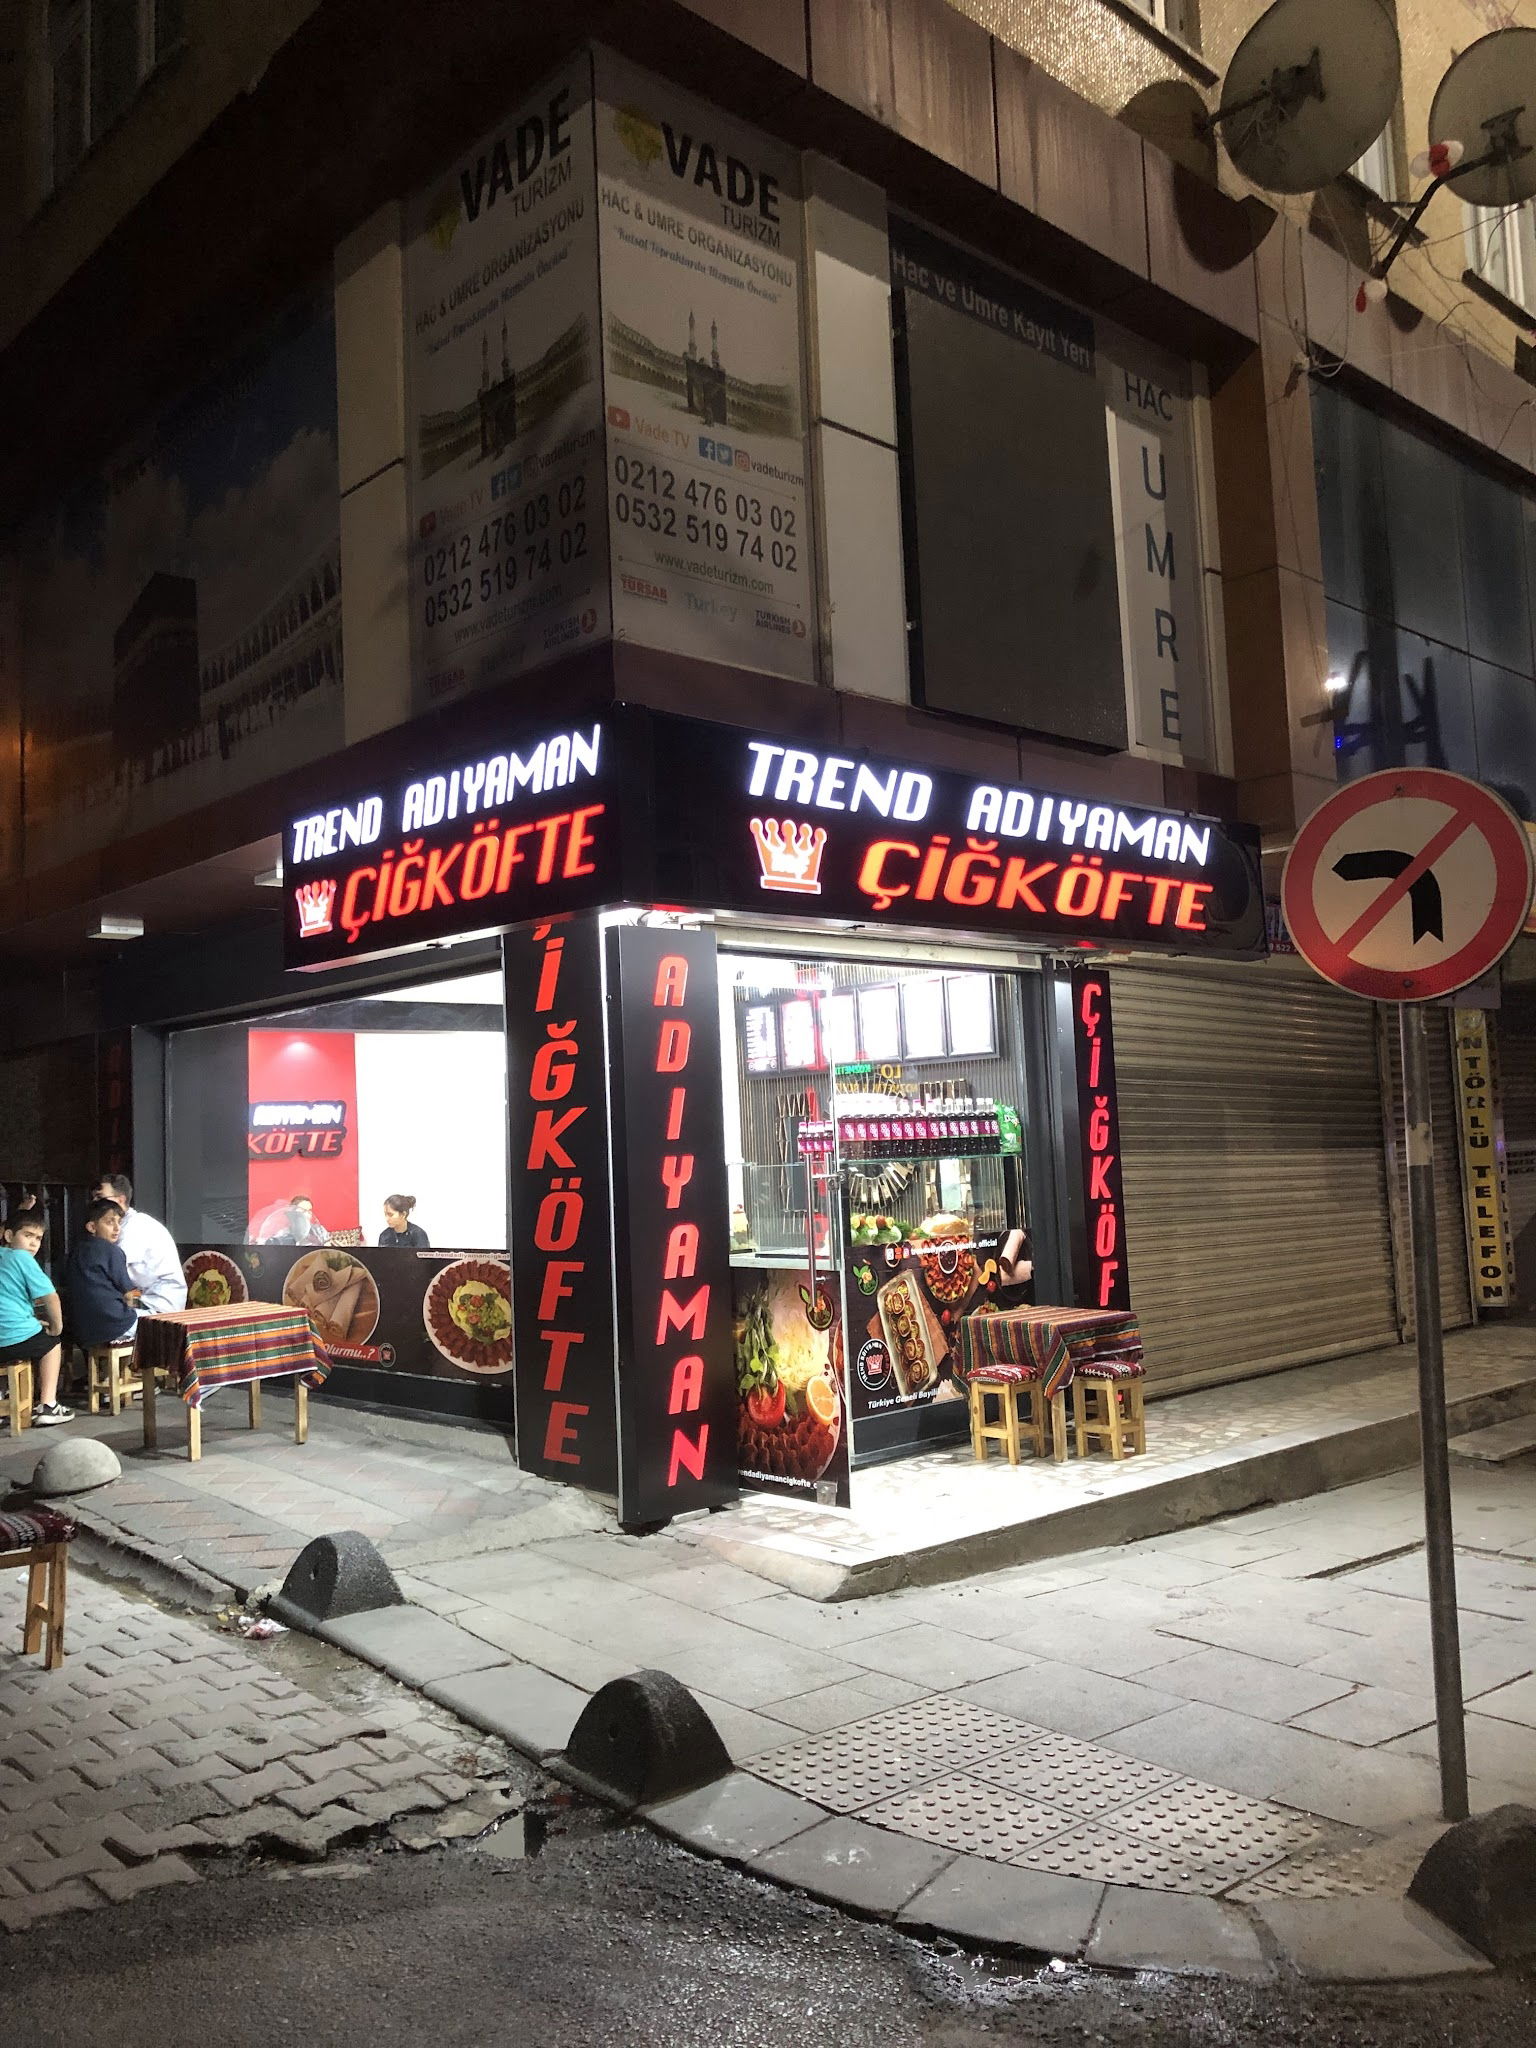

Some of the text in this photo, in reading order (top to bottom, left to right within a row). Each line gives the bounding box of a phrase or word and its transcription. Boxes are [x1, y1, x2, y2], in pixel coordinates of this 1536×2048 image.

[460, 86, 571, 223] VADE
[660, 120, 781, 224] VADE
[602, 187, 631, 216] HAC
[635, 203, 643, 222] &
[647, 209, 684, 241] UMRE
[415, 308, 437, 337] HAC
[450, 277, 481, 316] UMRE
[891, 249, 930, 290] Hac
[934, 273, 957, 302] ve
[961, 286, 1009, 328] Umre
[633, 416, 690, 449] Vade TV
[1124, 368, 1173, 421] HAC
[614, 455, 797, 538] 0212 476 03 02
[751, 461, 804, 487] vadeturizm
[423, 475, 586, 587] 0212 476 03 02
[425, 521, 588, 628] 0532 519 74 02
[615, 492, 798, 573] 0532 519 74 02
[654, 549, 775, 595] www.vadeturizm.com
[755, 609, 791, 625] TURKISH
[755, 618, 792, 636] AIRLINES
[1141, 445, 1183, 742] UMRE
[292, 723, 602, 864] TREND ADIYAMAN
[748, 741, 1211, 867] TREND ADIYAMAN
[340, 804, 606, 944] ÇİĞKÖFTE
[856, 834, 1215, 931] ÇİĞKÖFTE
[248, 1127, 342, 1155] KÖFTE
[1081, 983, 1119, 1307] ÇİĞKÖF
[526, 924, 589, 1466] İĞKÖFTE
[653, 955, 711, 1488] ADIYAMAN
[1471, 1165, 1504, 1299] TELEFON
[868, 1398, 895, 1410] Türkiye
